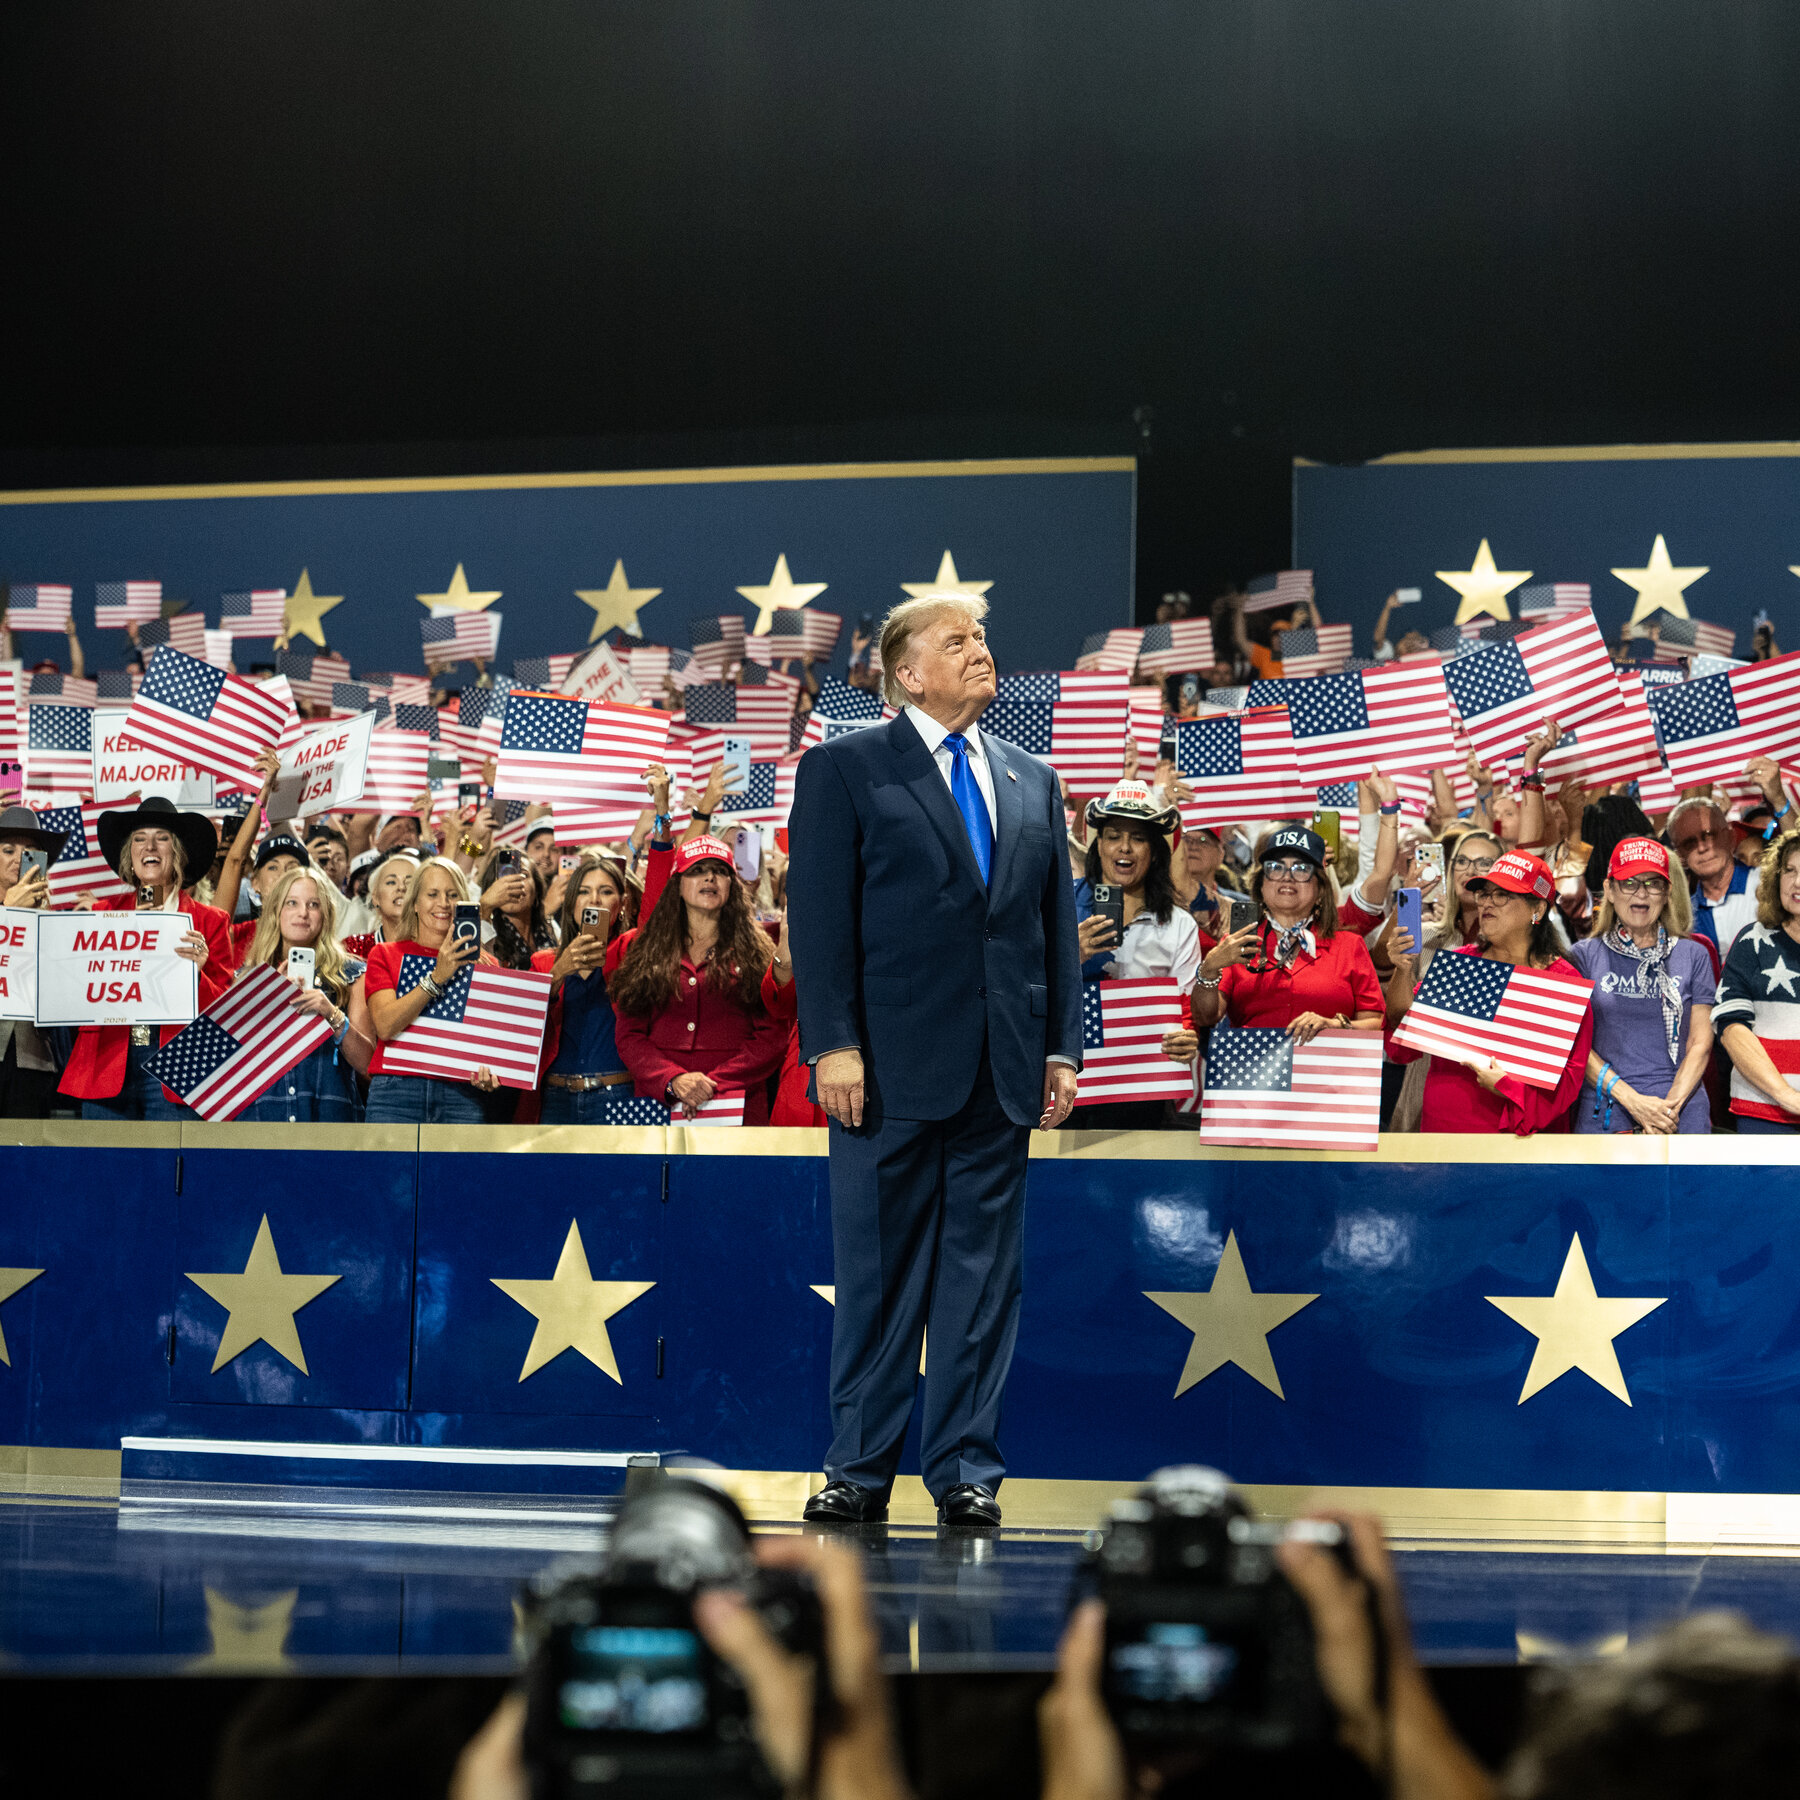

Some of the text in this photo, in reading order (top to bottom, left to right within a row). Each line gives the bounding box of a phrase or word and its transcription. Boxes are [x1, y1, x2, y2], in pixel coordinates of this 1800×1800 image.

[1640, 669, 1684, 683] ARRIS
[294, 733, 350, 768] MADE
[302, 760, 335, 782] IN THE
[297, 778, 332, 804] USA
[1116, 790, 1147, 801] TRUMP
[1275, 831, 1310, 850] USA
[1623, 841, 1649, 850] TRUMP
[684, 845, 728, 859] GREAT AGAIN
[1620, 848, 1643, 858] RIGHT
[1620, 854, 1665, 867] EVERYTHING
[1500, 865, 1525, 881] AGAIN
[72, 930, 159, 952] MADE
[88, 960, 141, 972] IN THE
[86, 981, 142, 1004] USA
